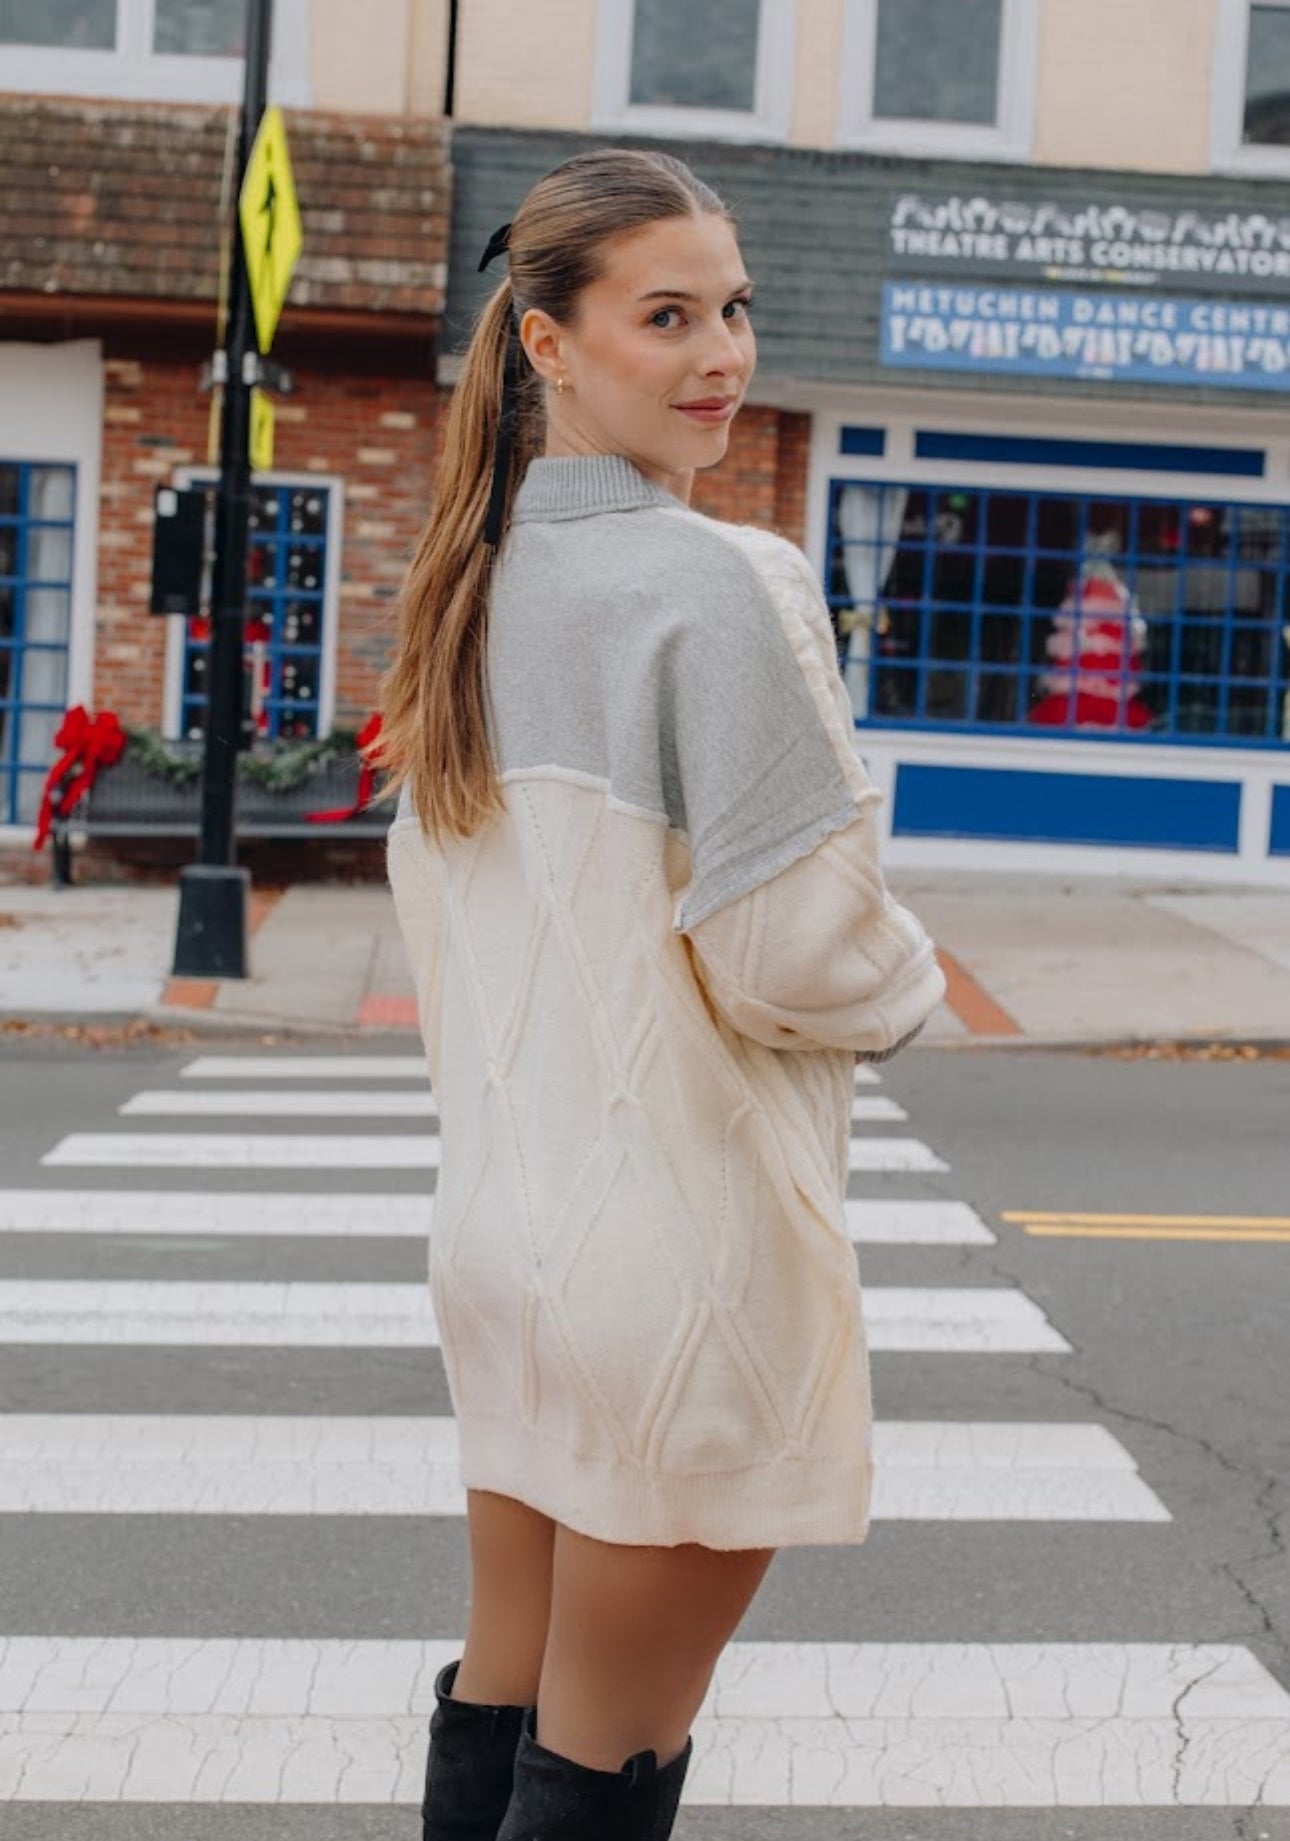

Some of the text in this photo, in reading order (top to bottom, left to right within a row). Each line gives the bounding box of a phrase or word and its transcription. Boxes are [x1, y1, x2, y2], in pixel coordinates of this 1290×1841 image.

[890, 229, 1008, 260] THEATRE
[1014, 236, 1085, 264] ARTS
[891, 287, 1059, 320] METUCHEN
[1072, 298, 1176, 329] DANCE
